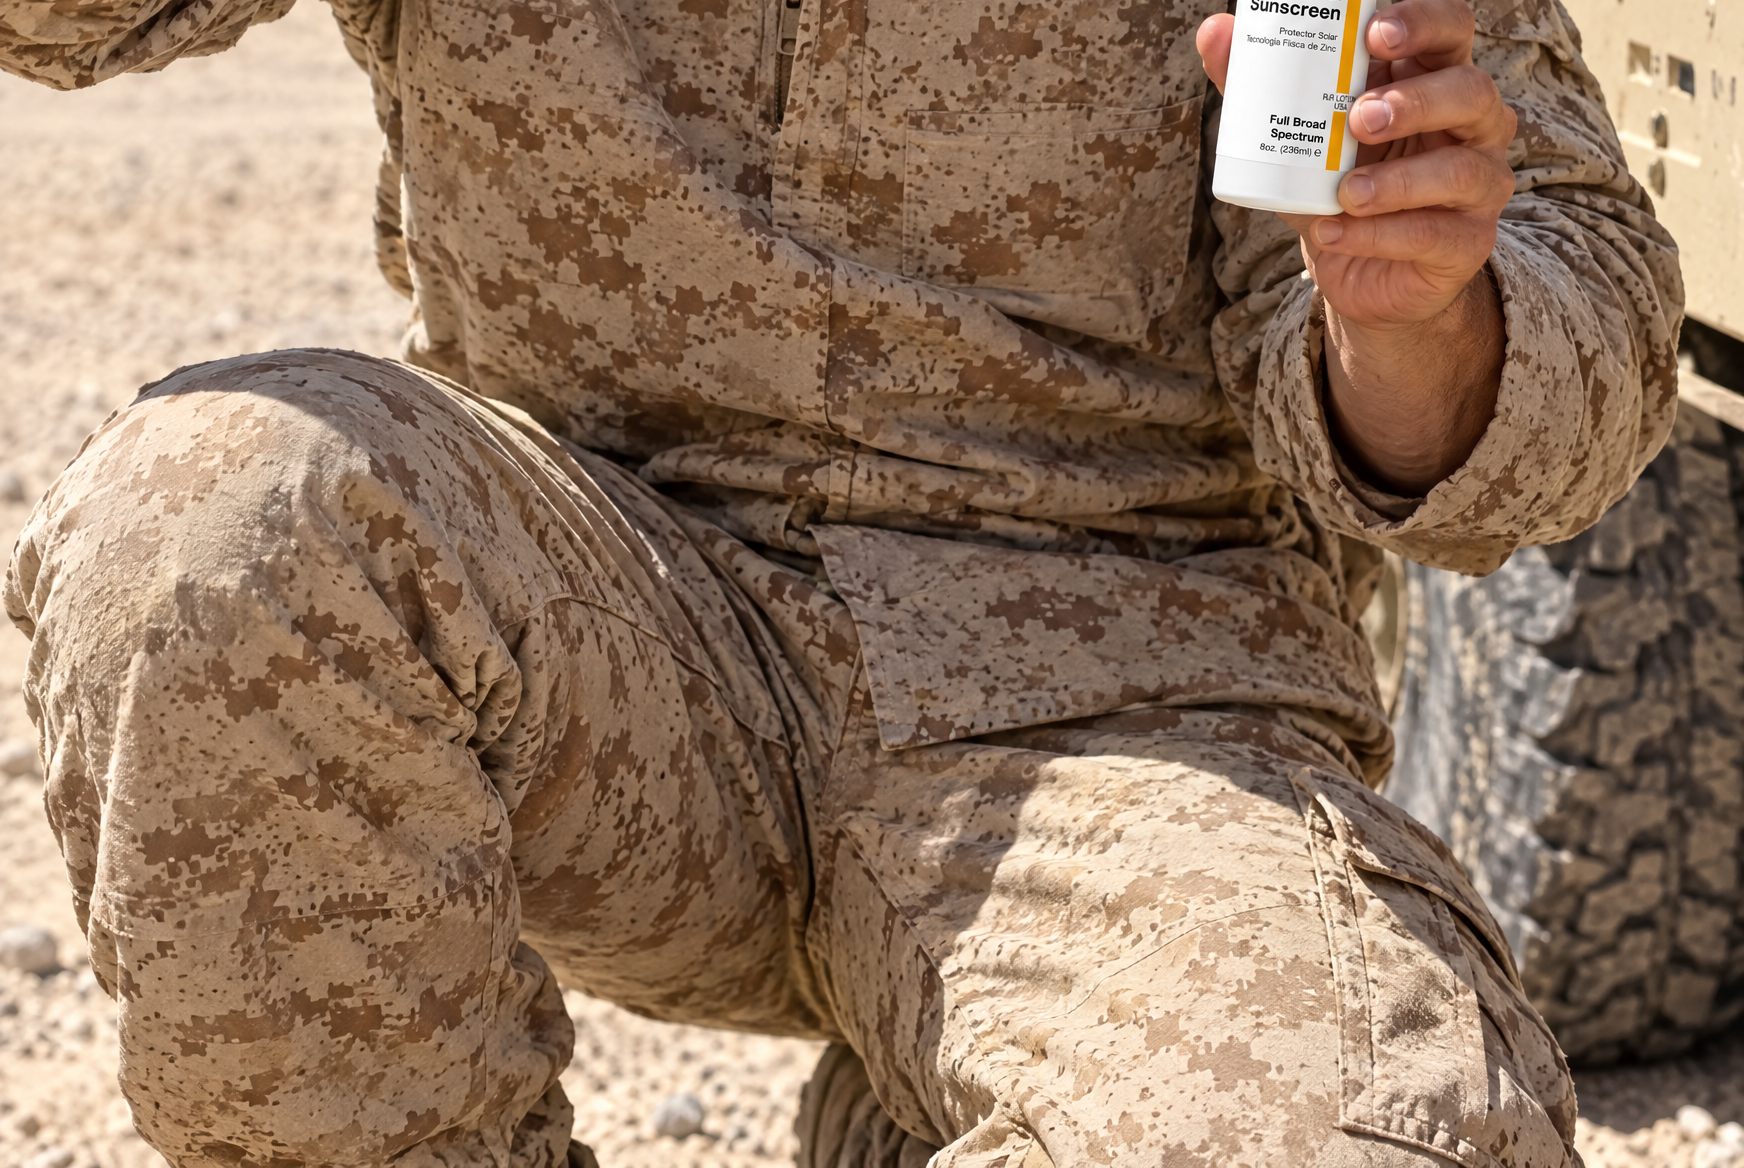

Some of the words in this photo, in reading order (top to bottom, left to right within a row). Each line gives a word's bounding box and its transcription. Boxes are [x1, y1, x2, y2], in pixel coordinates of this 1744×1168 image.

[1279, 27, 1316, 38] Protector
[1307, 42, 1319, 50] de
[1319, 43, 1337, 53] Zinc
[1269, 114, 1290, 126] Full
[1293, 117, 1327, 130] Broad
[1270, 128, 1324, 144] Spectrum
[1259, 142, 1277, 153] 8oz.
[1280, 144, 1312, 157] (236ml)
